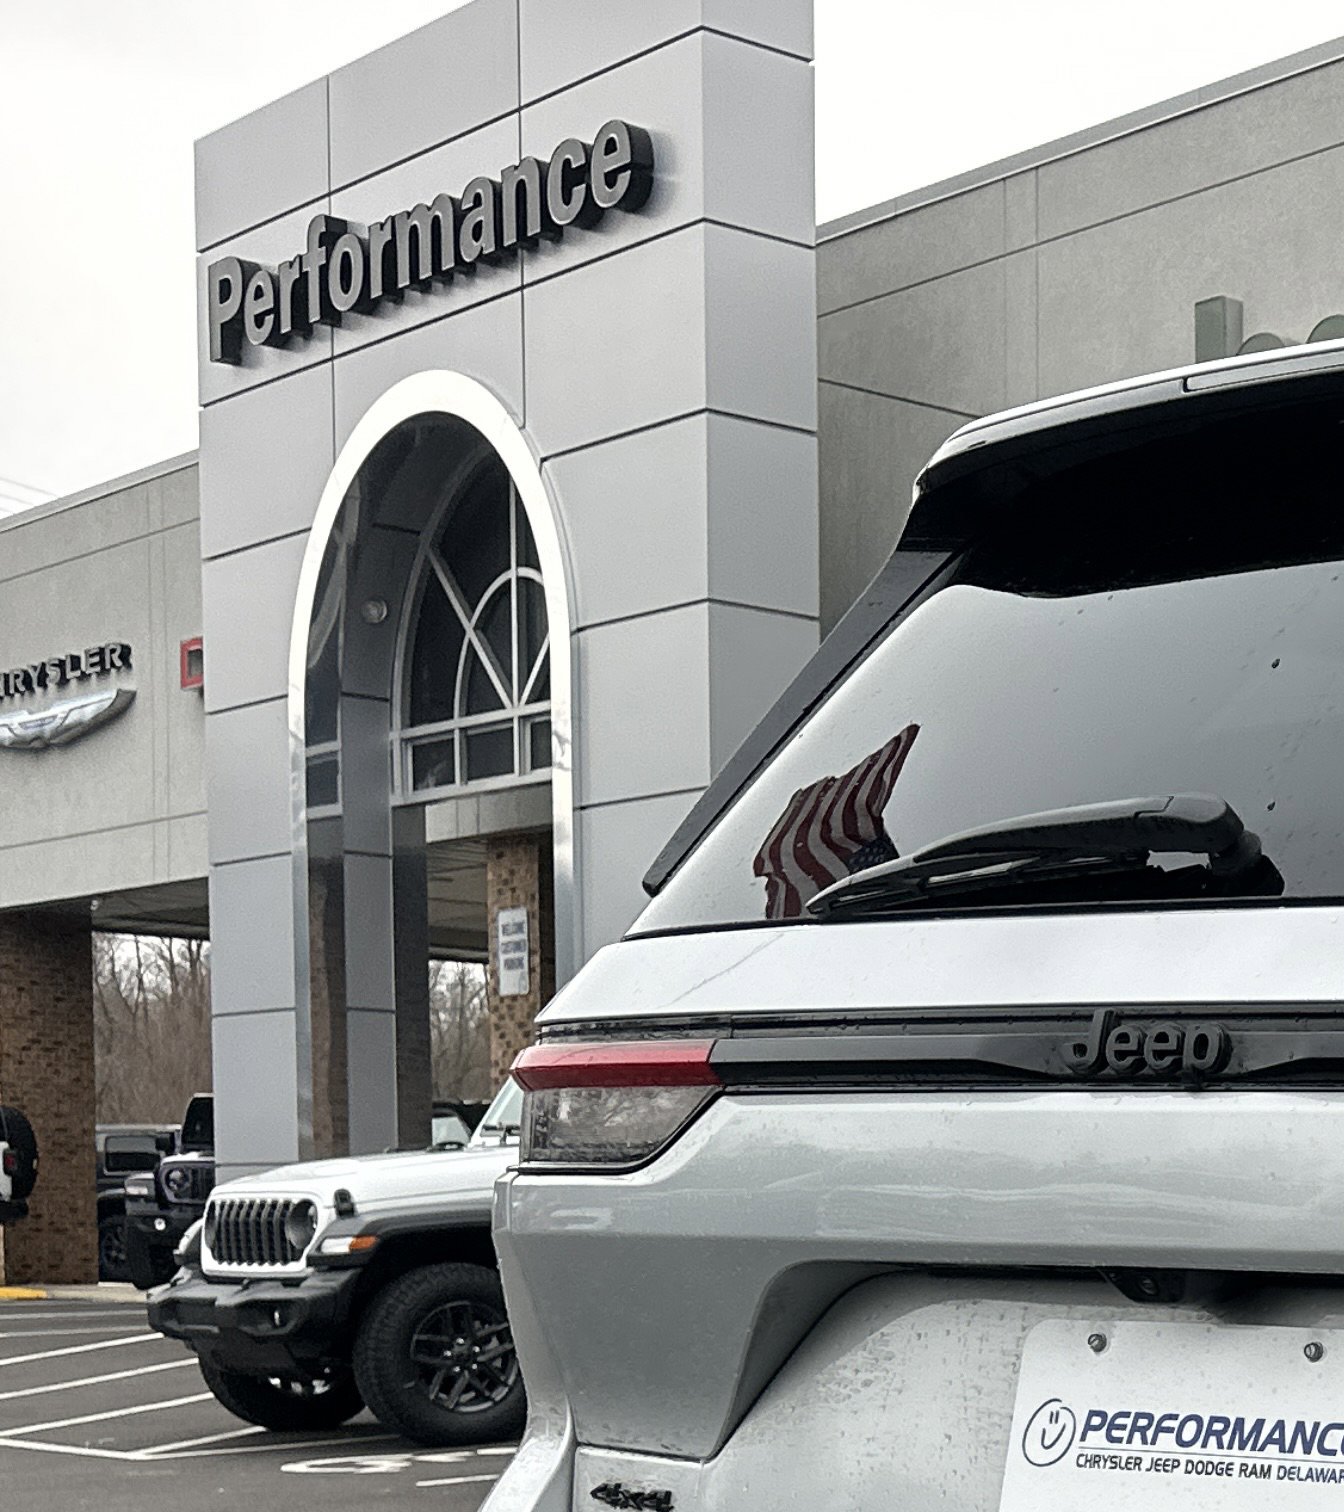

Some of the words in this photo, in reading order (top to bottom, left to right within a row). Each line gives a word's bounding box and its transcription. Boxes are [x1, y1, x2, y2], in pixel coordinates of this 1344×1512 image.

[208, 119, 654, 364] Performance
[1061, 1007, 1233, 1089] Jeep
[1076, 1453, 1143, 1472] CHRYSLER
[1145, 1457, 1181, 1473] JEEP
[1184, 1459, 1235, 1477] DODGE
[1238, 1462, 1272, 1480] RAM
